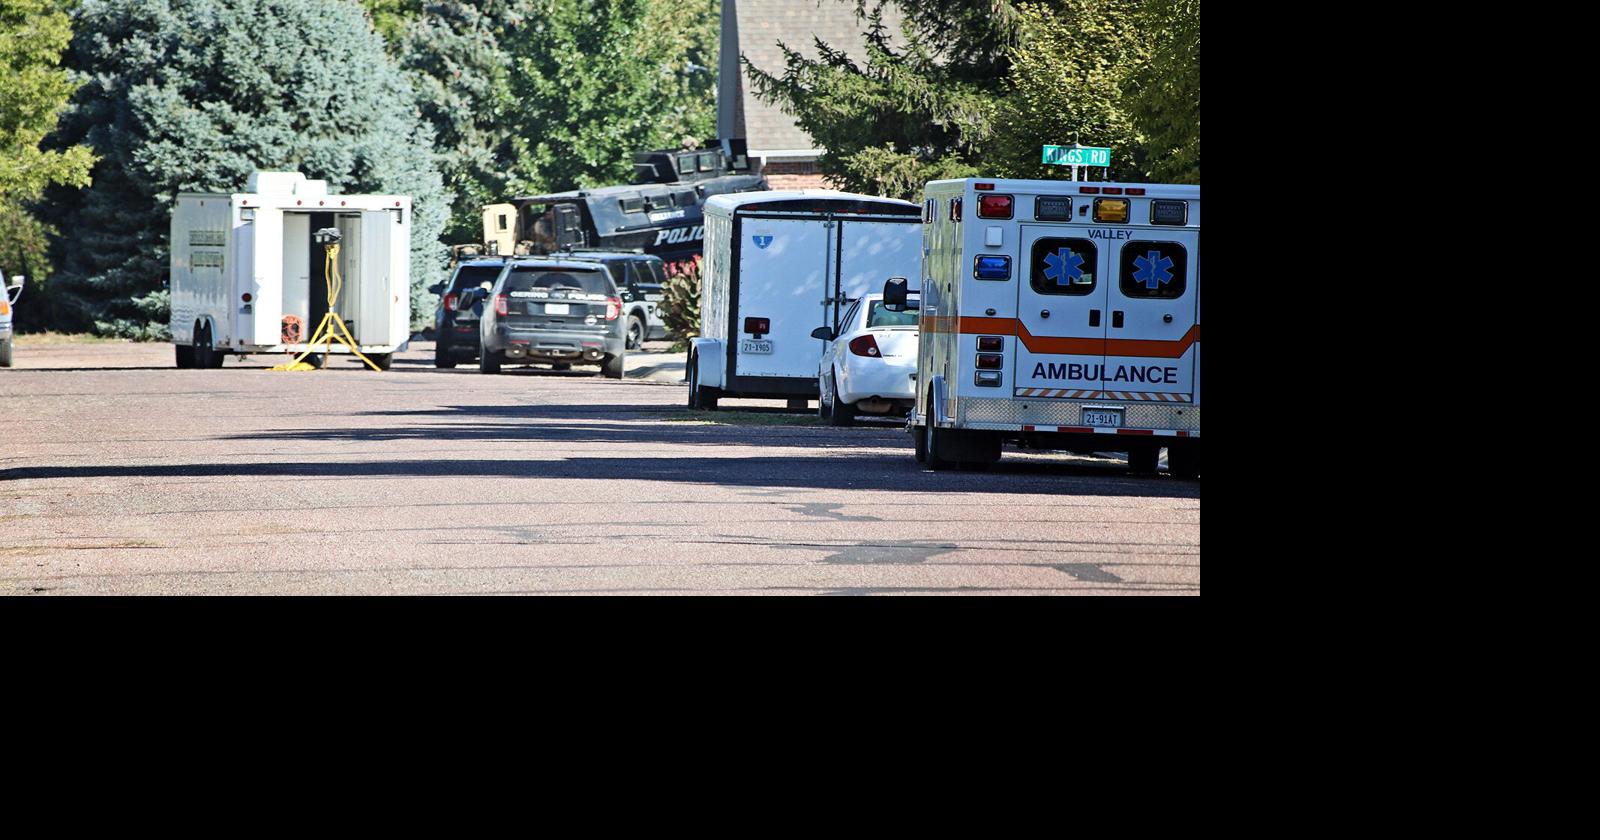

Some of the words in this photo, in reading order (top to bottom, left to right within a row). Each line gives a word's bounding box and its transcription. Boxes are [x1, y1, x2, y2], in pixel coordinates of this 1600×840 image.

[1047, 147, 1083, 163] KINGS
[1091, 149, 1107, 164] RD
[1087, 229, 1133, 240] VALLEY
[759, 236, 766, 246] 1
[1031, 362, 1178, 384] AMBULANCE
[1086, 413, 1118, 425] 21-91AT
